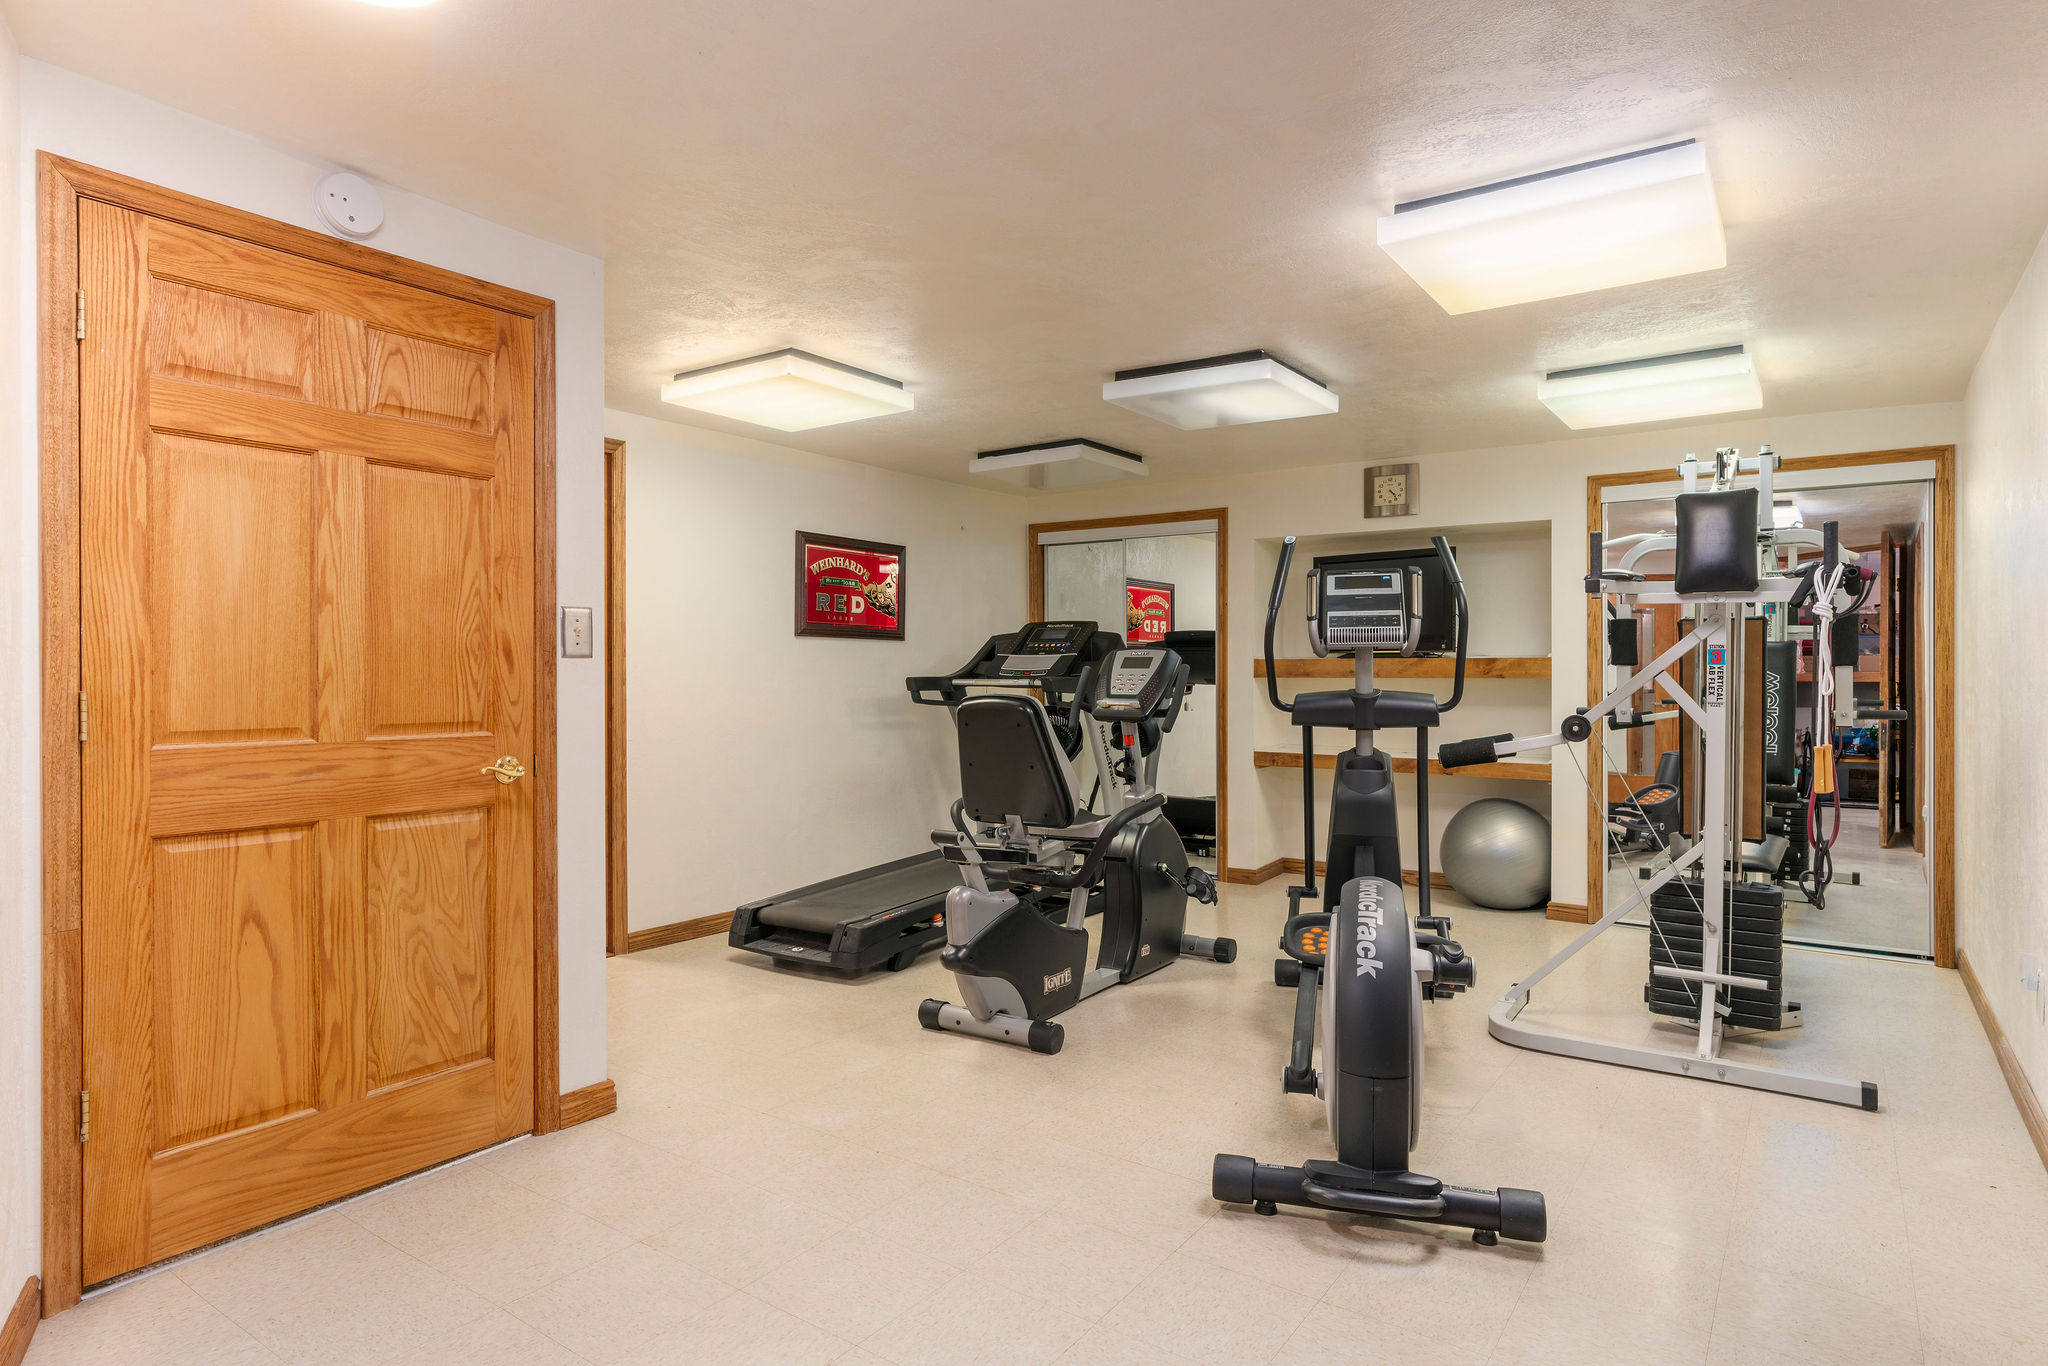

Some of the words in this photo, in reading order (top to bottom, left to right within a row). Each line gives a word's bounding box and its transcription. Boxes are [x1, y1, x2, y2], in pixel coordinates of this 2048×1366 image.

[809, 556, 871, 582] WEINHARD'S
[816, 592, 866, 615] RED
[1710, 650, 1723, 664] 3
[1708, 665, 1716, 676] AB
[1708, 677, 1716, 696] FLEX
[1716, 665, 1725, 702] VERTICAL
[1099, 724, 1118, 790] NordicTrack
[1356, 879, 1384, 979] NordicTrack
